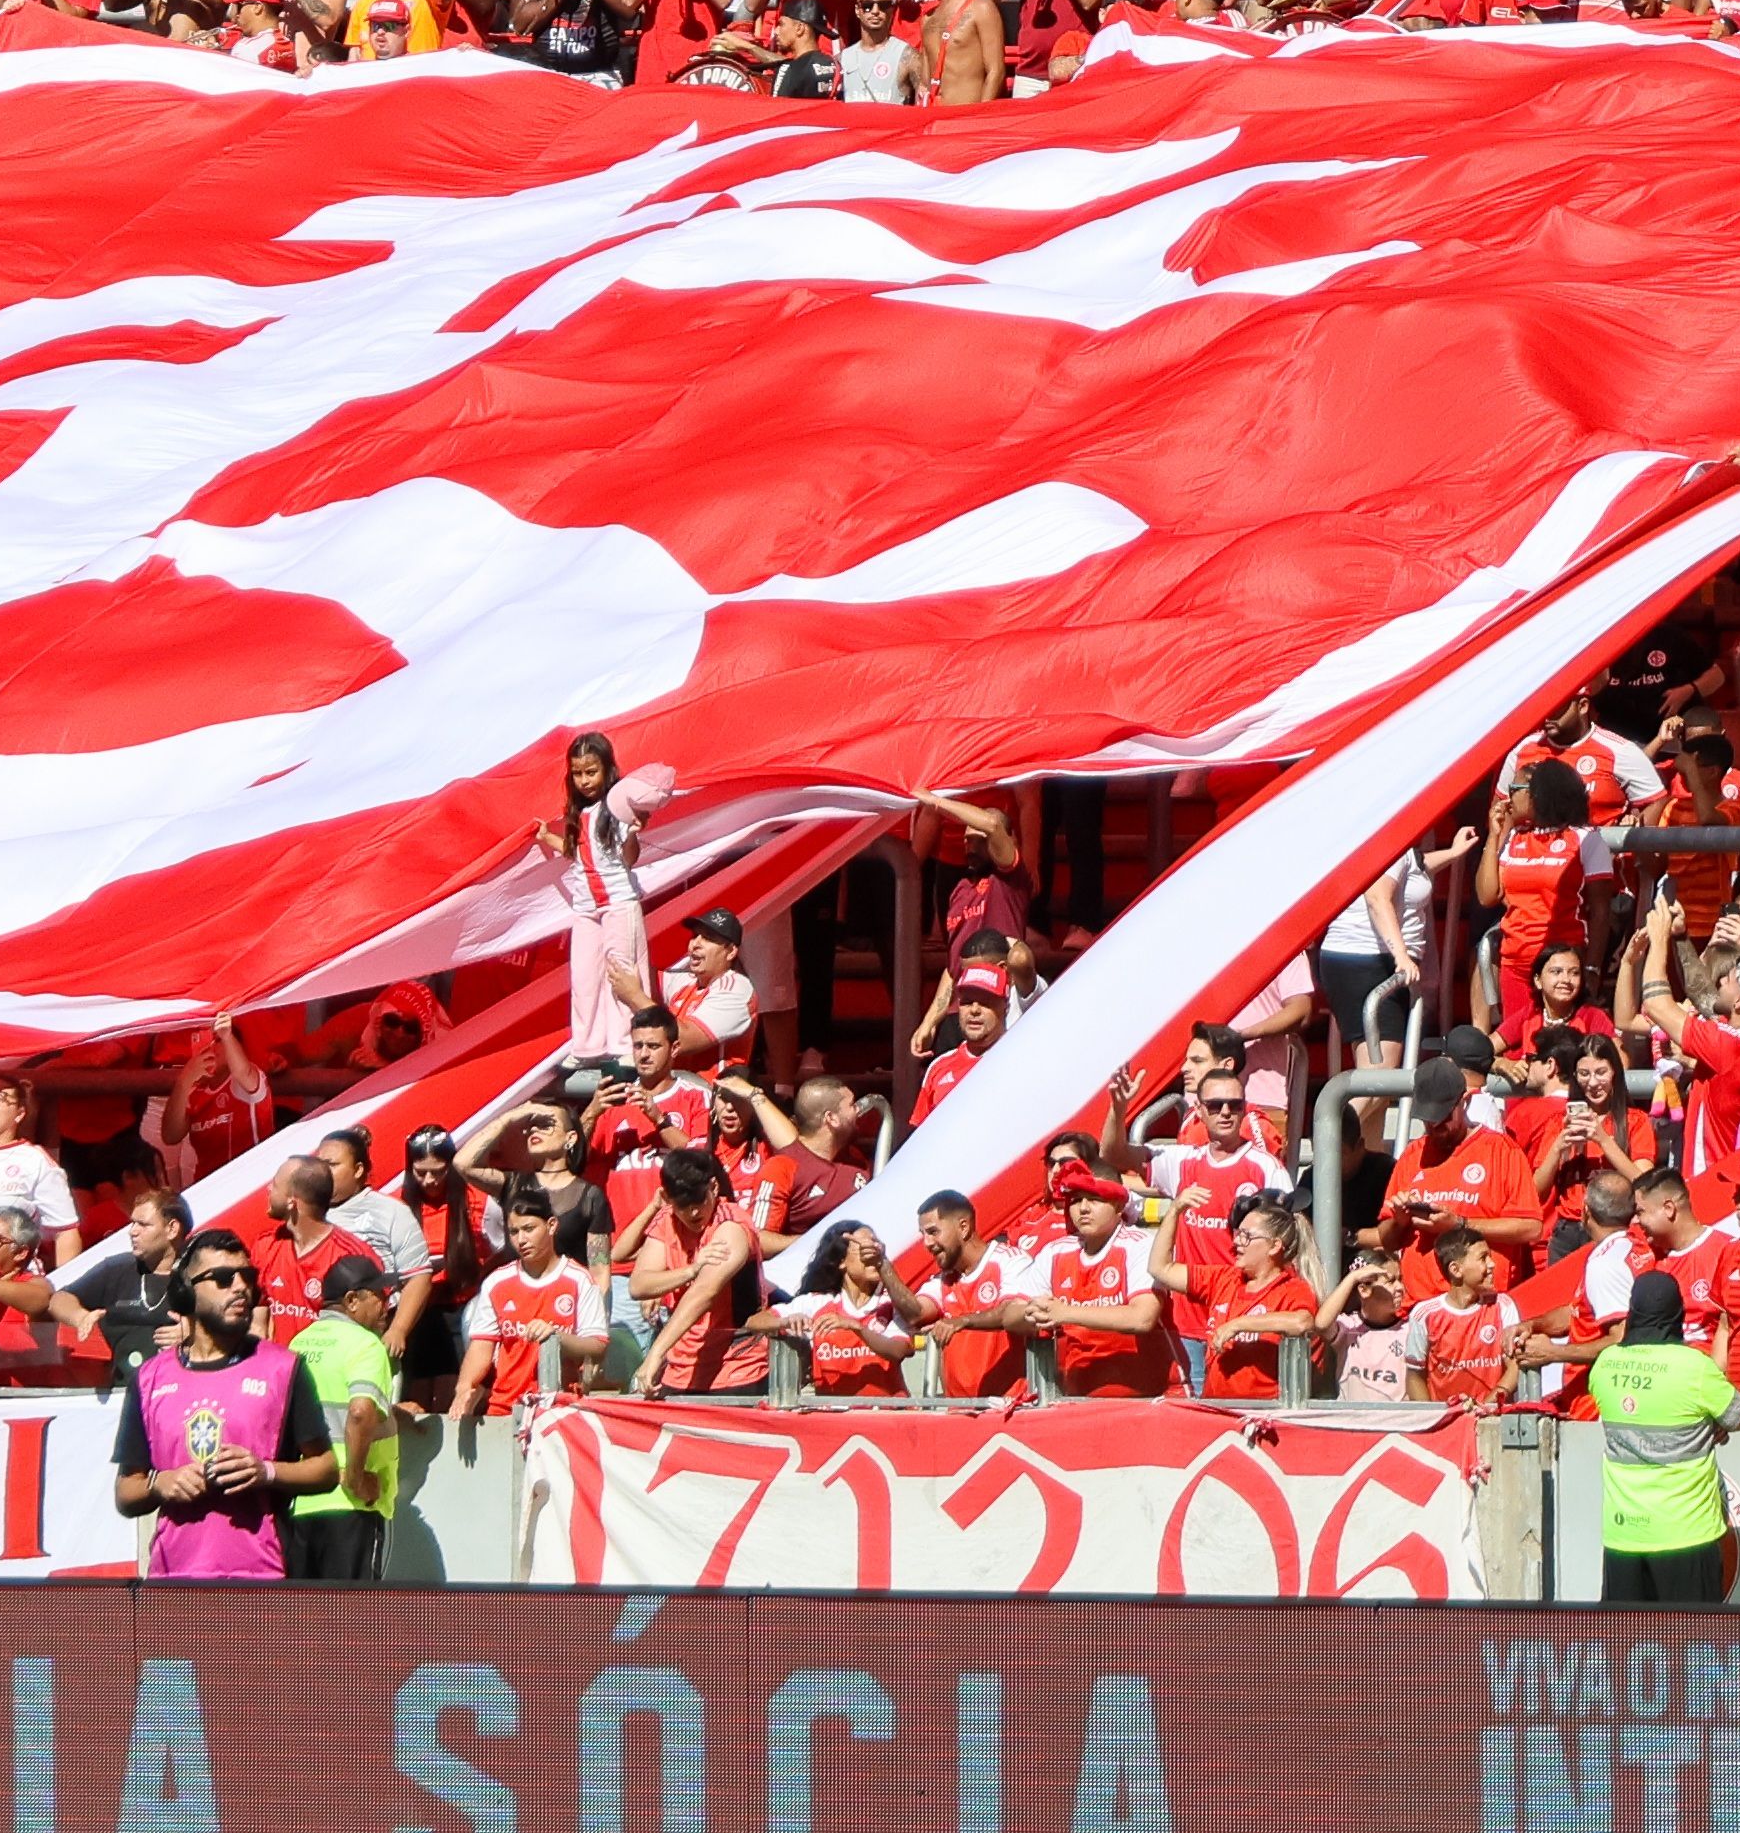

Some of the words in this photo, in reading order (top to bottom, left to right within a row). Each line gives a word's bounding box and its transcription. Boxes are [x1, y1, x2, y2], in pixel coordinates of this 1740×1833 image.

[1423, 1190, 1479, 1206] banrisul
[1348, 1366, 1398, 1385] alfa
[1600, 1359, 1669, 1374] ORIENTADOR
[241, 1378, 267, 1397] 903
[1611, 1373, 1653, 1390] 1792
[1481, 1639, 1616, 1717] VIVA
[1625, 1640, 1670, 1717] O
